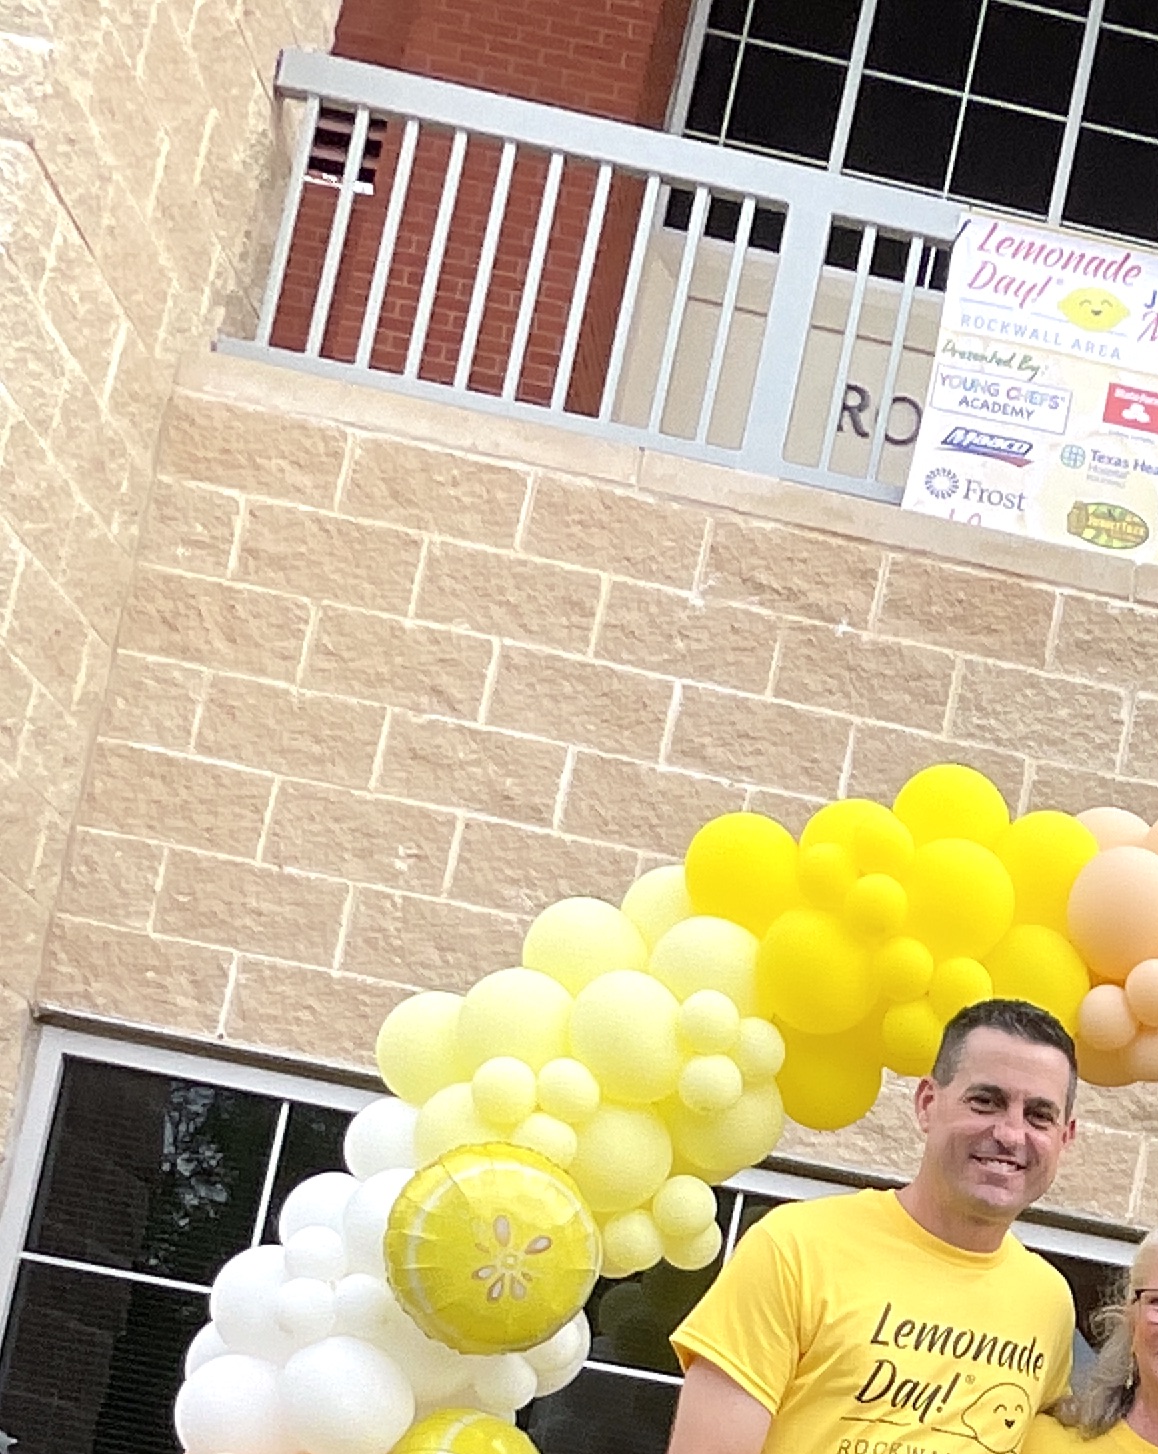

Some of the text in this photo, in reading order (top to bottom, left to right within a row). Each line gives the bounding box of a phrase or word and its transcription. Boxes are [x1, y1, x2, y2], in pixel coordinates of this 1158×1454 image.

[978, 222, 1142, 286] Lemonade
[967, 260, 1051, 309] Day!
[960, 313, 1122, 361] ROCKWALL AREA
[942, 339, 1050, 382] Presented By:
[940, 372, 1000, 398] YOUNG
[958, 395, 1035, 421] ACADEMY
[1091, 449, 1129, 469] Texas
[962, 478, 1026, 512] Frost
[870, 1301, 1044, 1382] Lemonade
[854, 1359, 961, 1424] Day!
